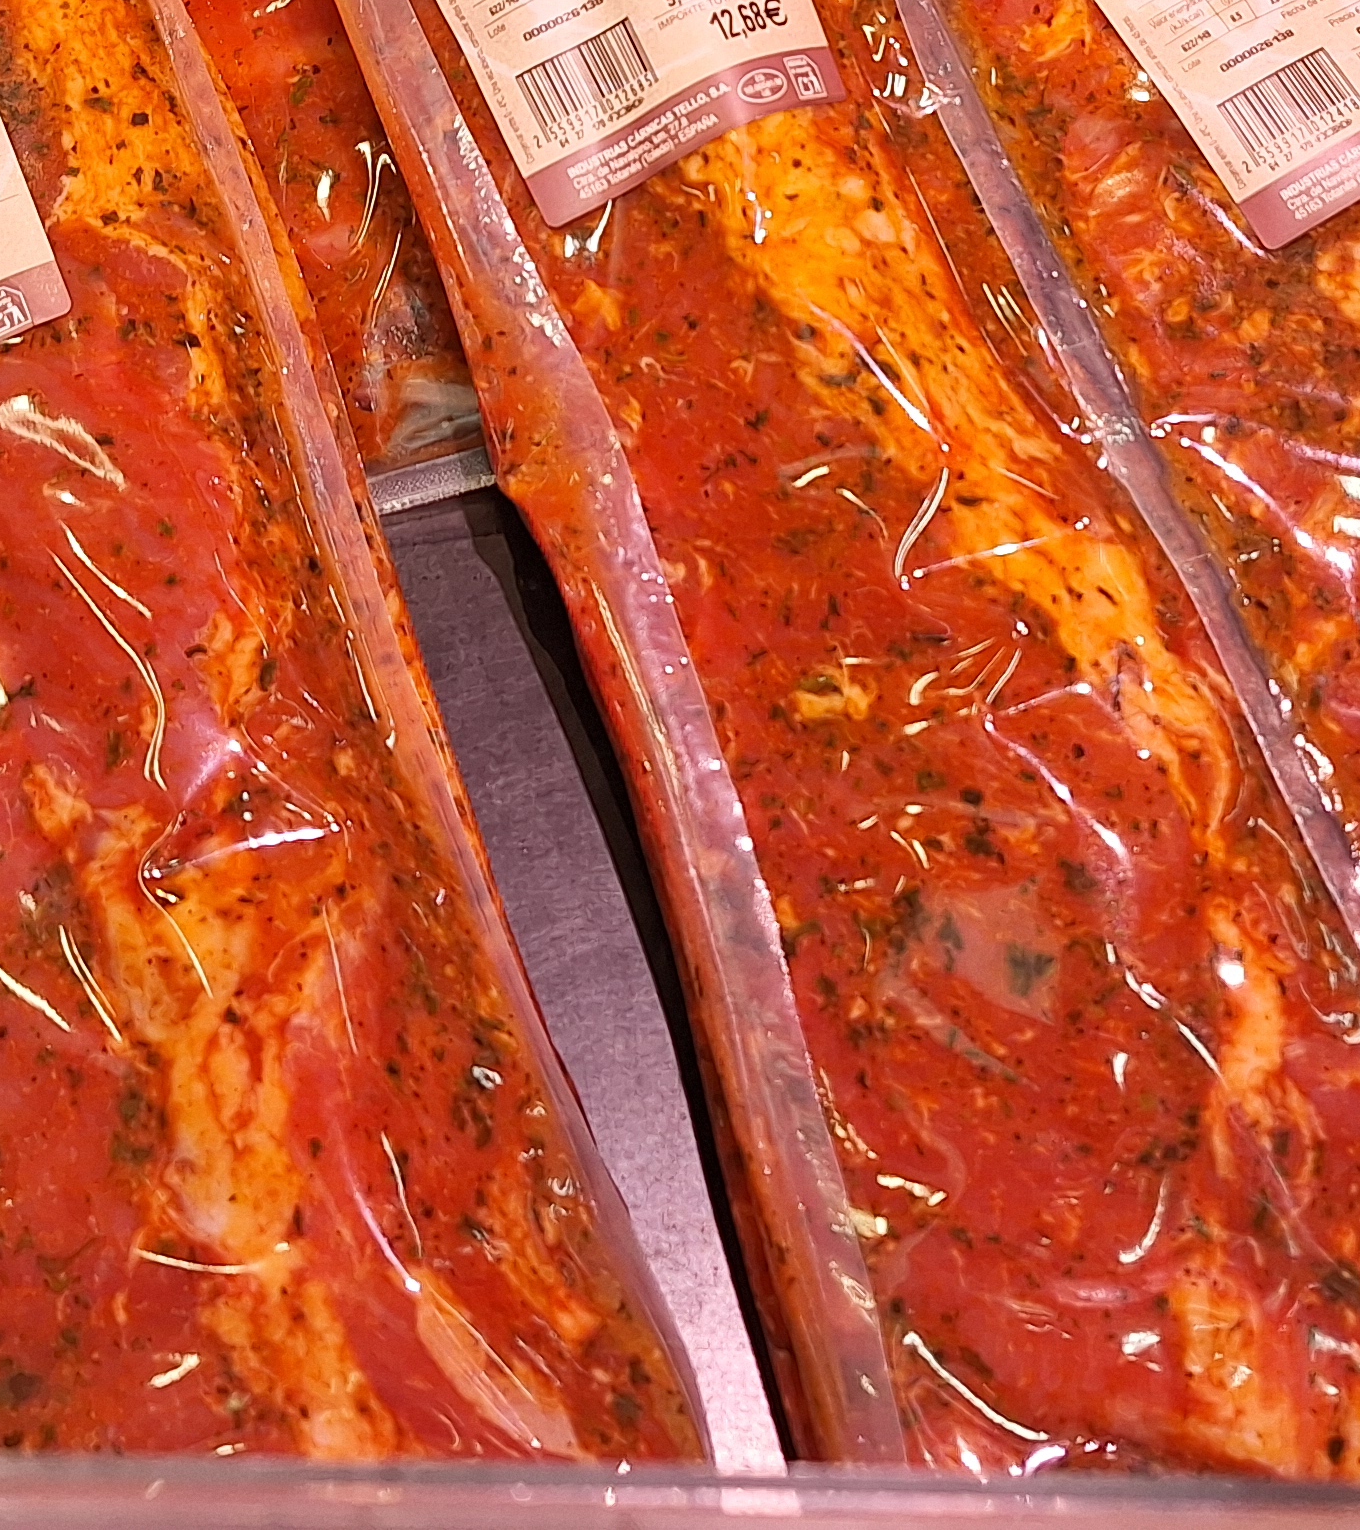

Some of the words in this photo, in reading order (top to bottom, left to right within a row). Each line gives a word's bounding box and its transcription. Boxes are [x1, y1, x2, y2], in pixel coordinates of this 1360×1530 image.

[1217, 26, 1295, 74] 0000026138
[565, 140, 630, 180] INDUSTRIAS
[1277, 158, 1342, 201] INDUSTRIAS
